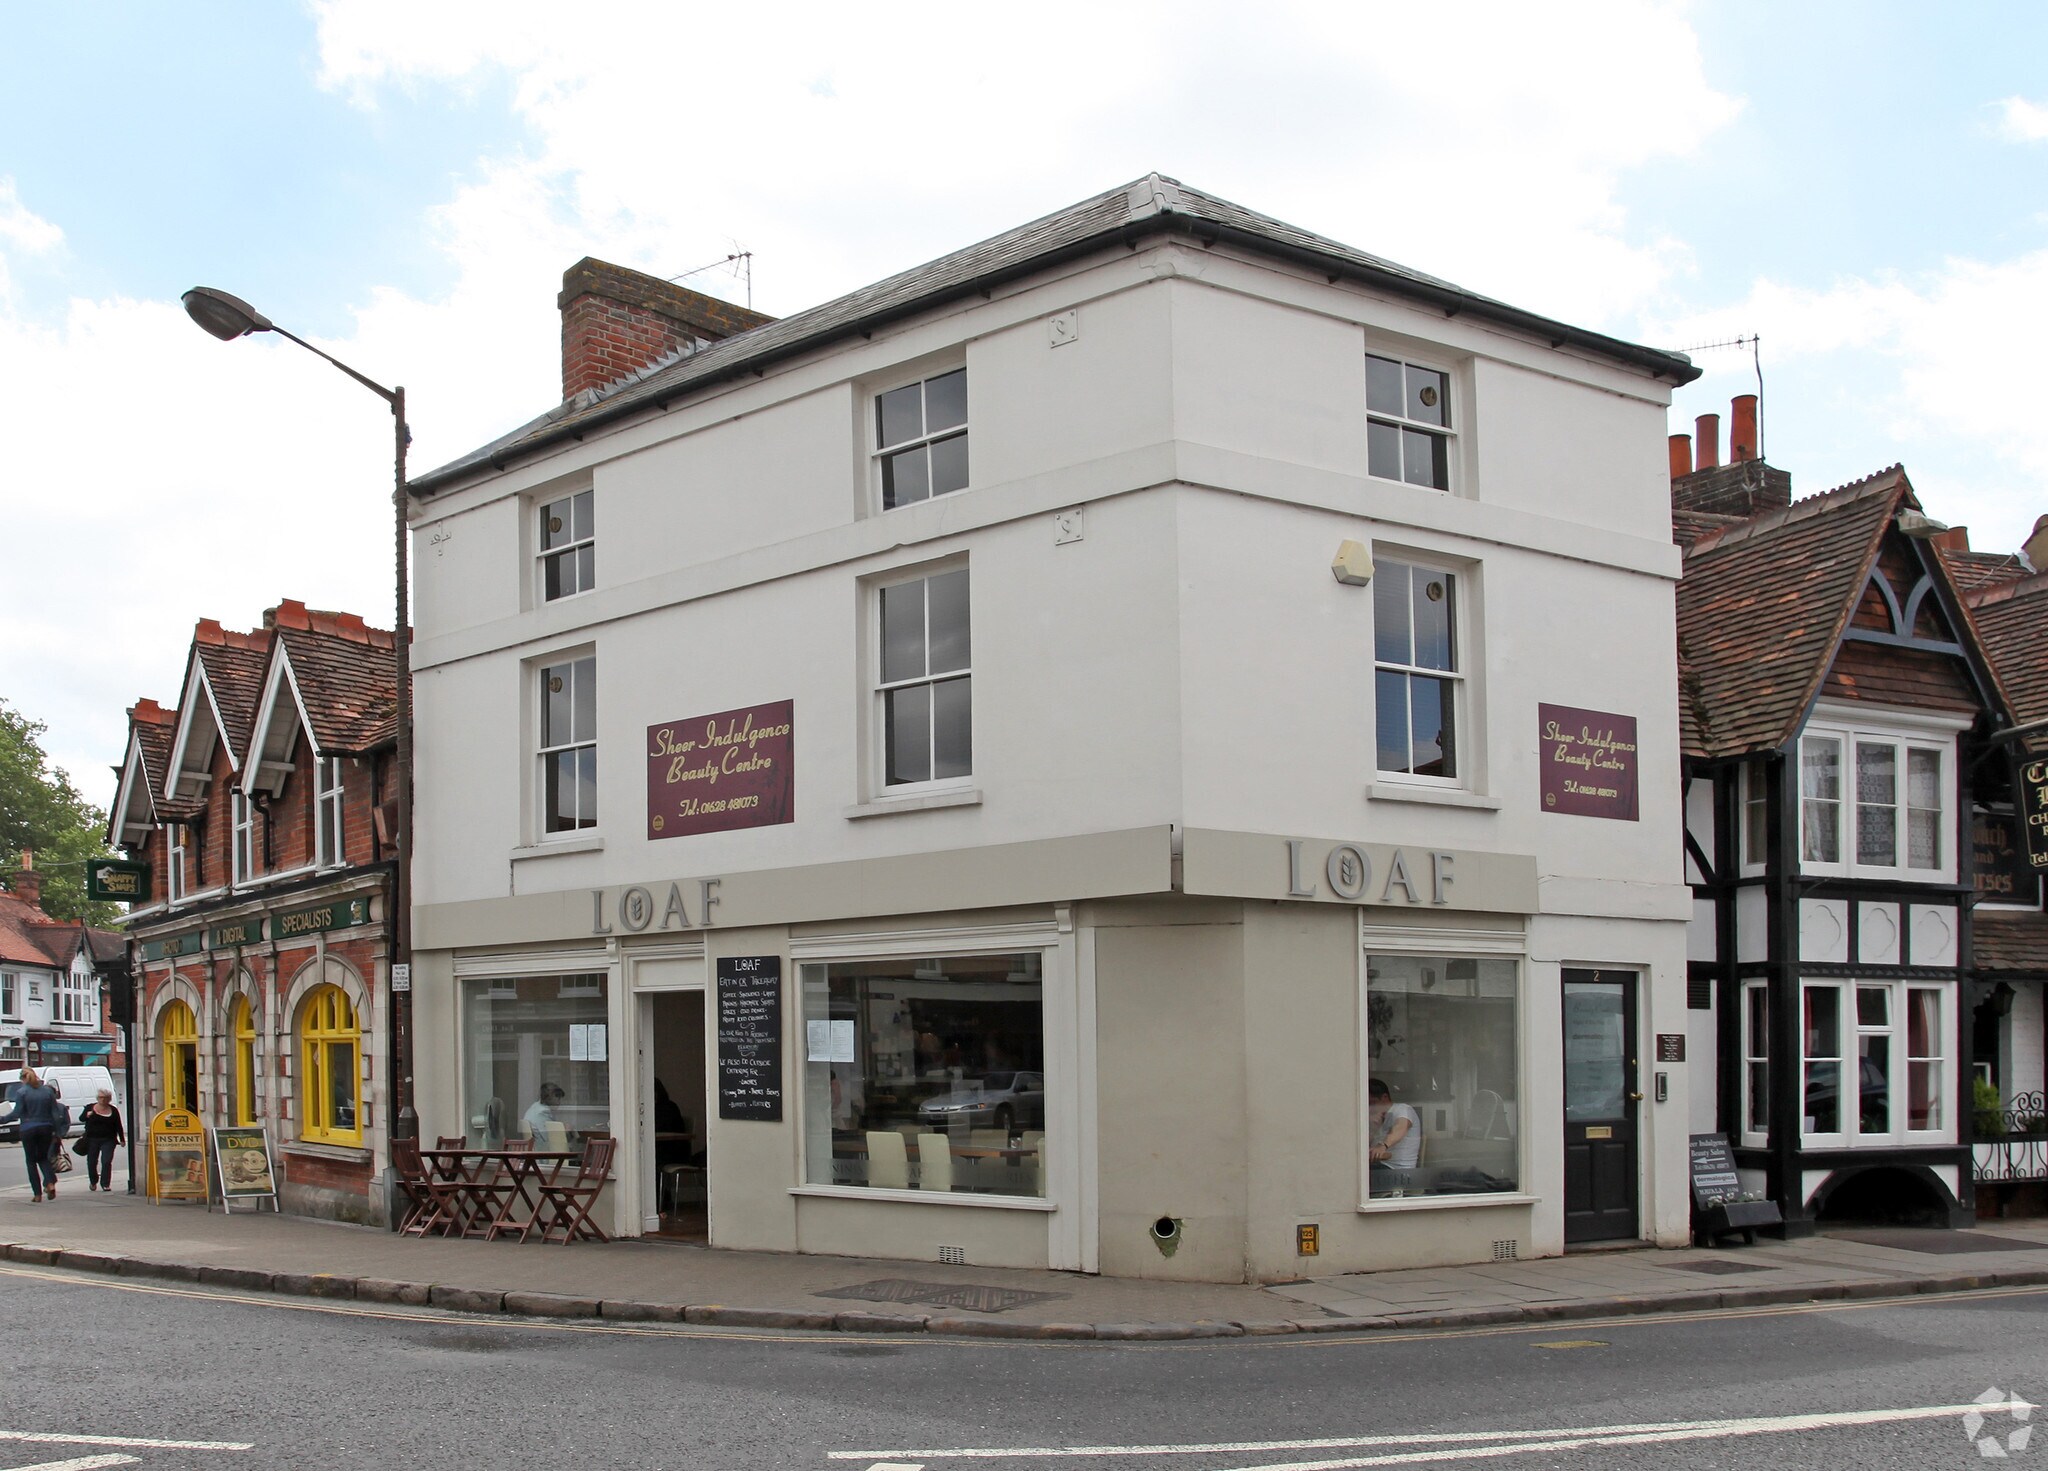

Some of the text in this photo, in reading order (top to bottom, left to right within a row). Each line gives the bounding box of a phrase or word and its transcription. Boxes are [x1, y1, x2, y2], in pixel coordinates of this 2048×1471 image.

[650, 713, 790, 757] Sheer Indulgence
[1543, 721, 1636, 754] Sheer Indulgence
[666, 746, 772, 784] Beauty Centre
[1554, 744, 1625, 771] Beauty Centre
[1283, 838, 1456, 906] LOAF
[591, 878, 720, 934] LOAF
[282, 908, 332, 934] SPECIALISTS
[222, 926, 246, 944] DIGITAL
[735, 959, 761, 971] LOAF
[1593, 971, 1600, 982] 2
[156, 1135, 200, 1143] INSTANT
[227, 1137, 259, 1148] DVD
